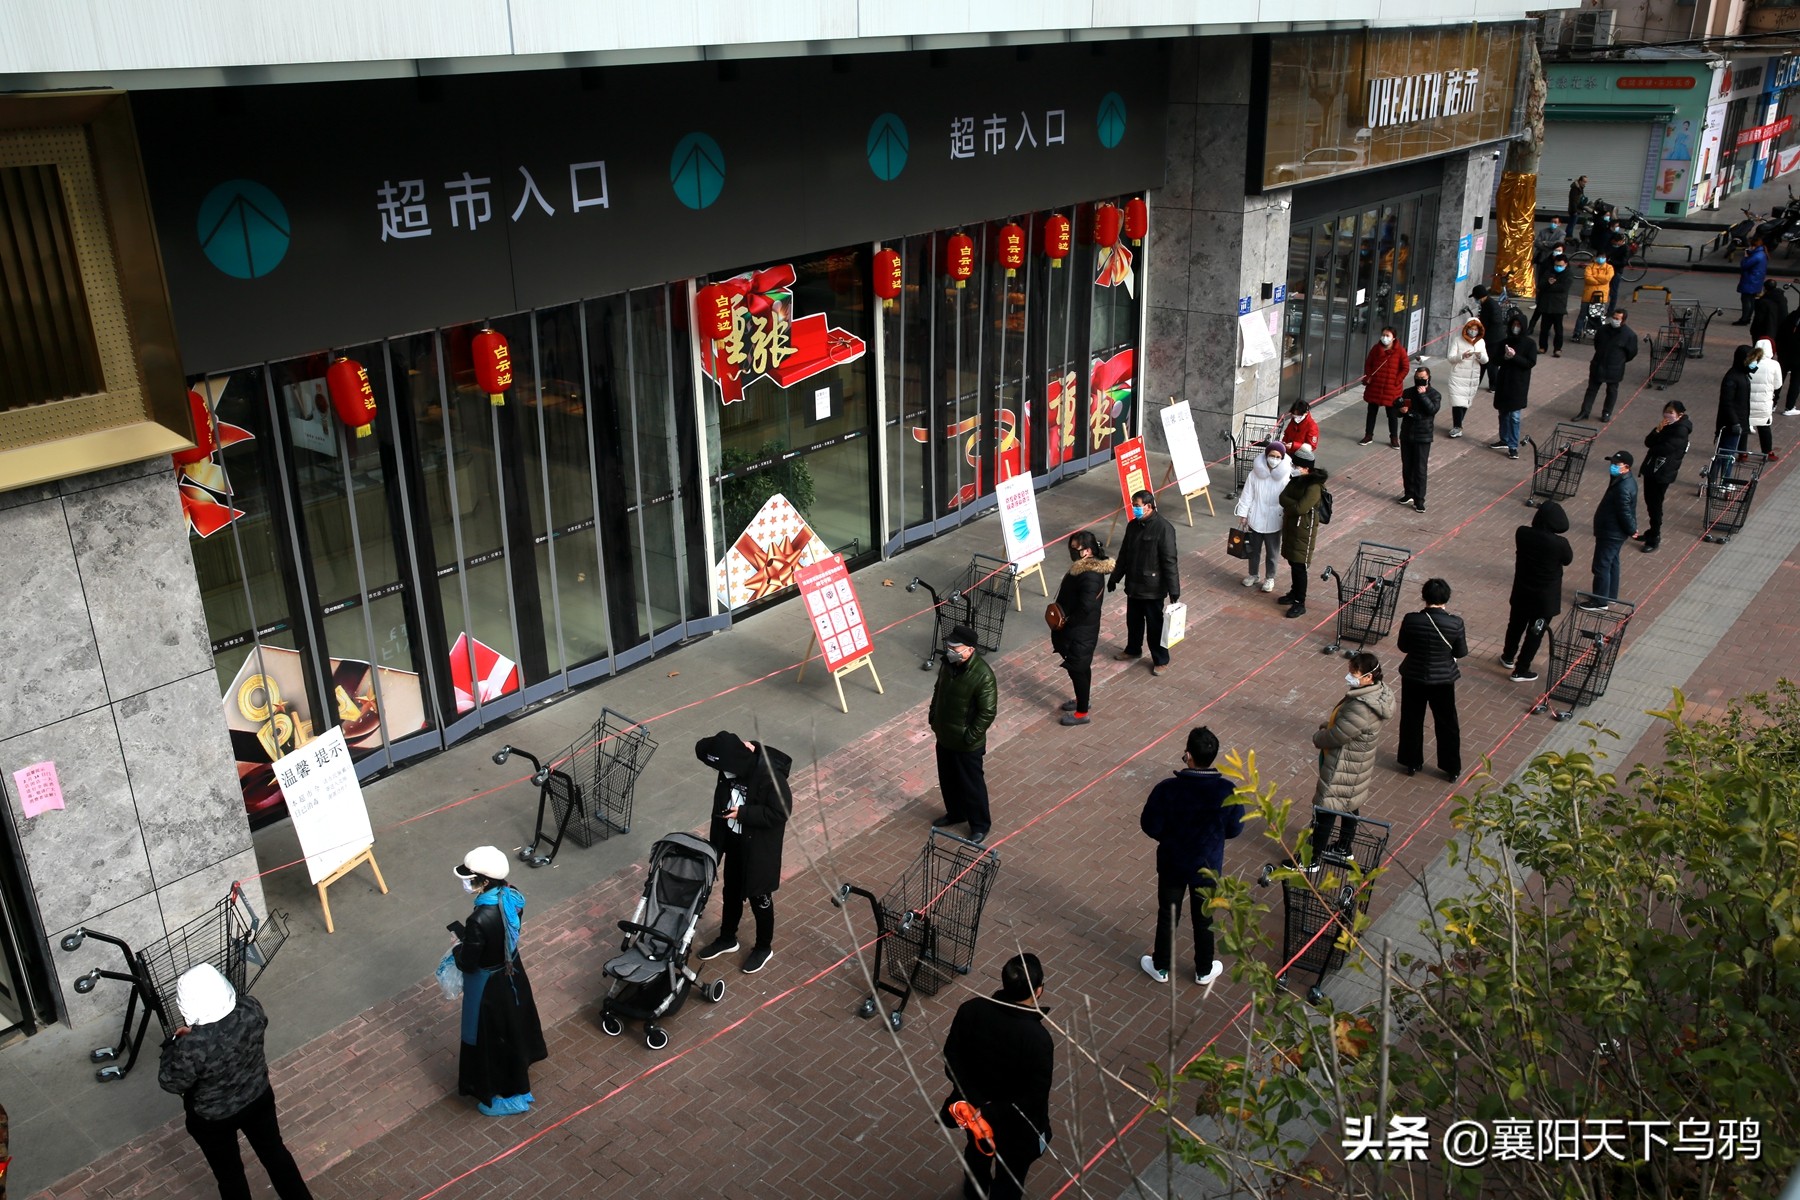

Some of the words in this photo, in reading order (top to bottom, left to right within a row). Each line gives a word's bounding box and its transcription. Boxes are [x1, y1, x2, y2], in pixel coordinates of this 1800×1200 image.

[1368, 73, 1441, 128] UHEALTH
[950, 109, 1066, 161] 超市入口
[377, 160, 610, 242] 超市入口
[1007, 234, 1021, 264] 白云边
[1058, 222, 1070, 251] 白云边
[957, 246, 971, 275] 白云边
[716, 295, 732, 331] 白云边
[493, 345, 512, 386] 白云边
